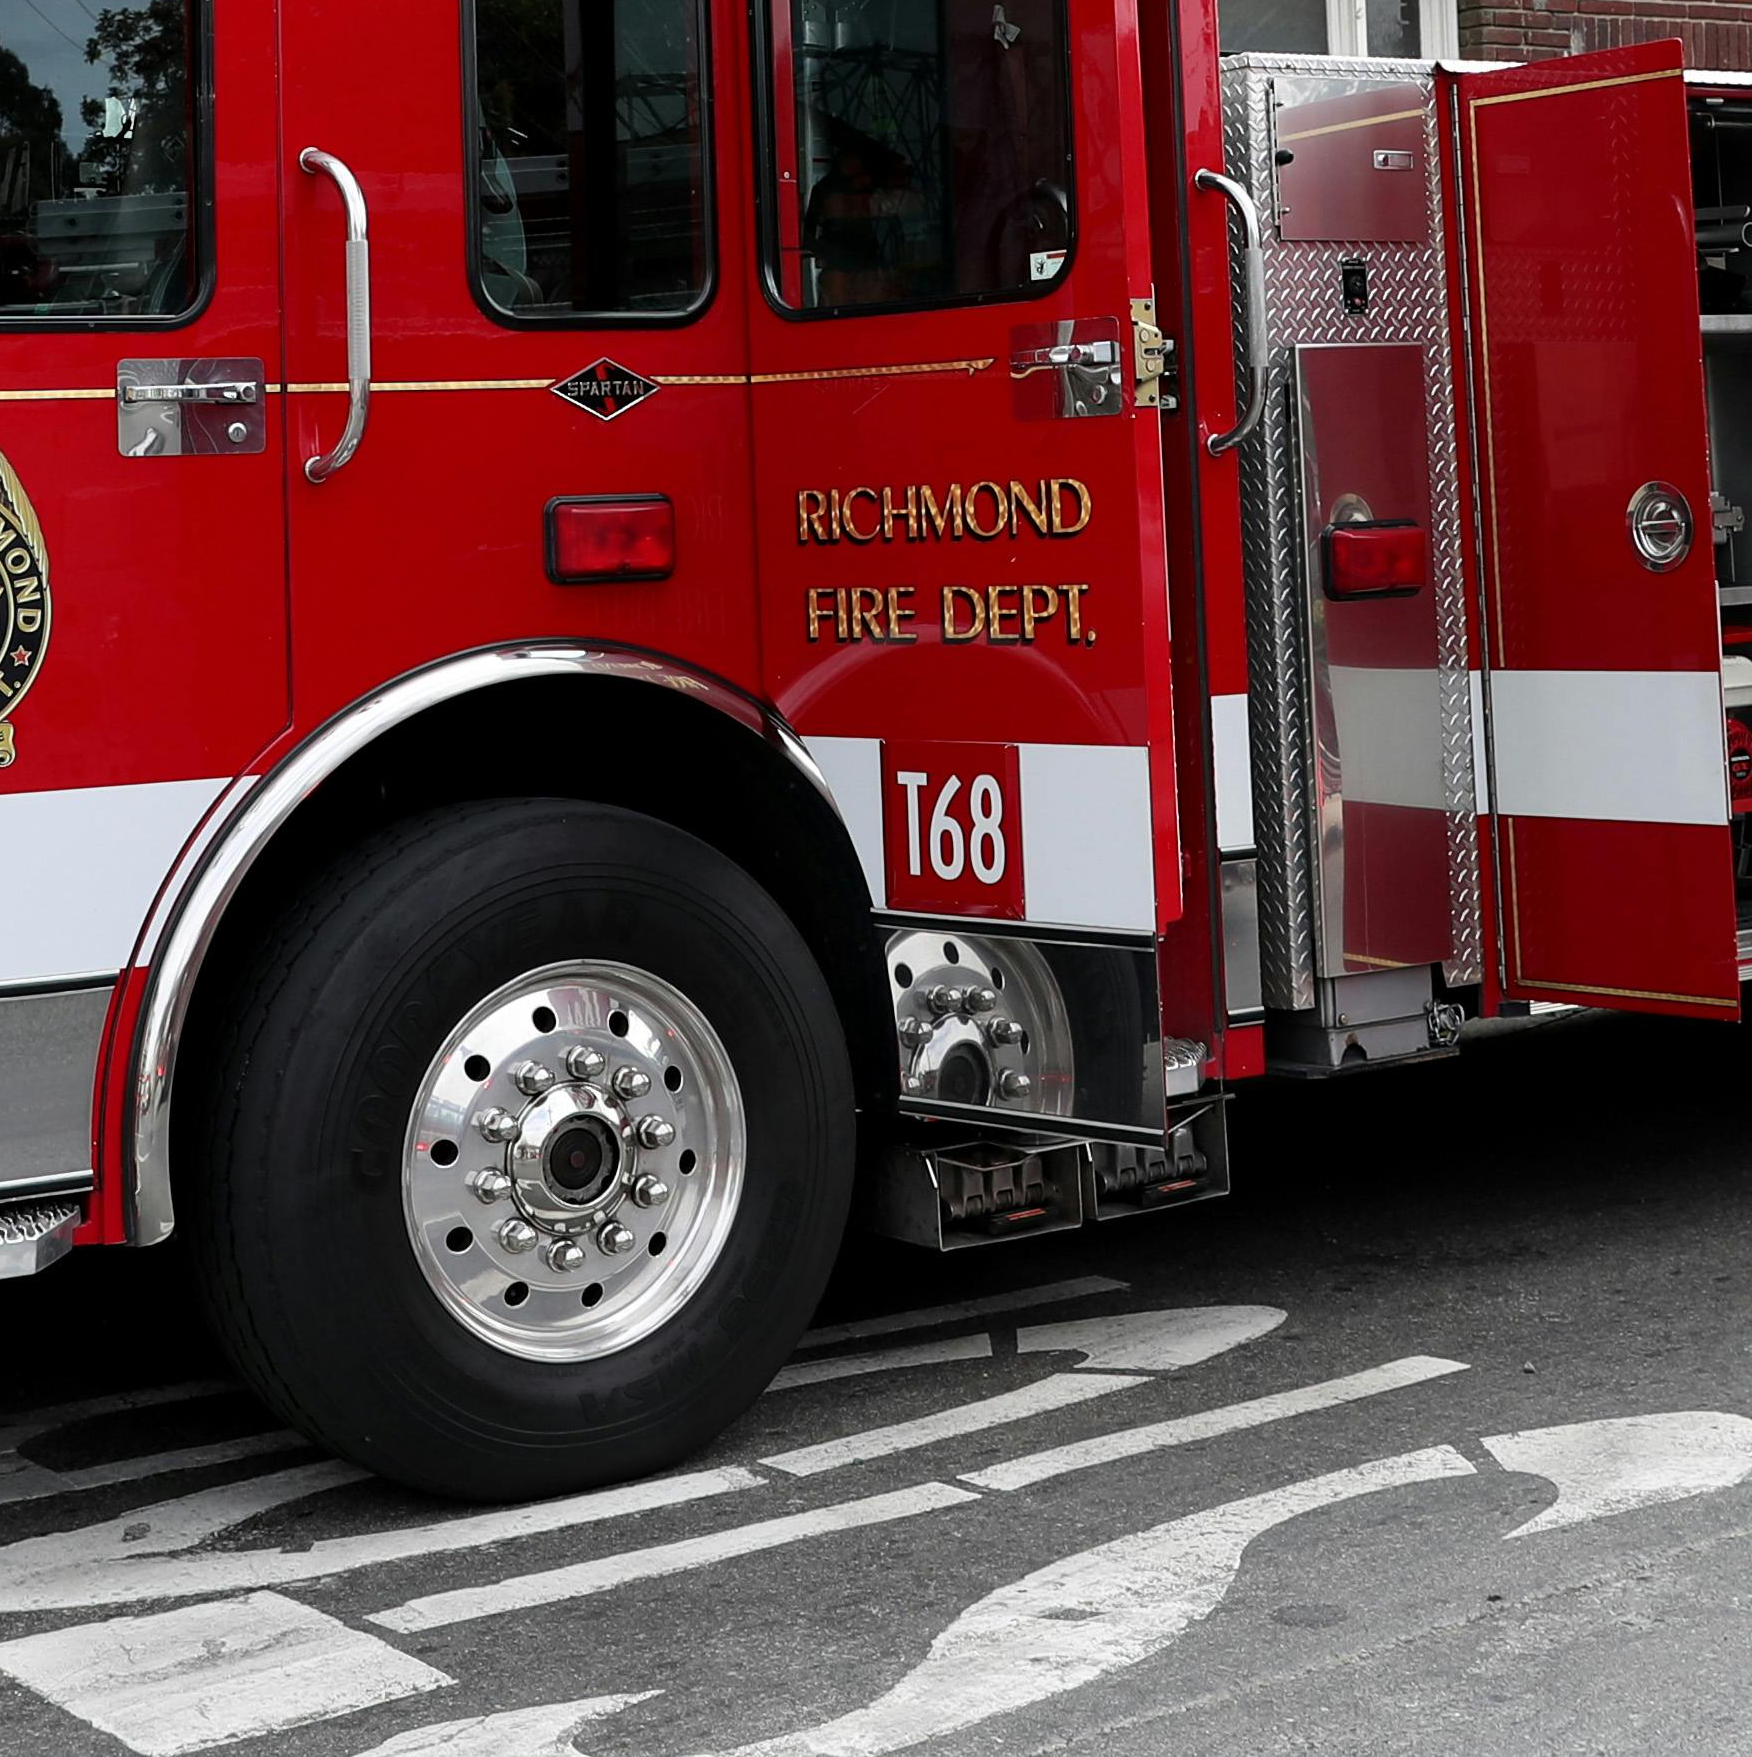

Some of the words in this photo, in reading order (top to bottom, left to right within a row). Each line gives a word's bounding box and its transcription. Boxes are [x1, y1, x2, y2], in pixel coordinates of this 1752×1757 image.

[566, 379, 645, 397] SPARTAN
[797, 478, 1093, 546] RICHMOND
[807, 586, 919, 643] FIRE
[941, 583, 1098, 648] DEPT.
[895, 769, 1007, 888] T68
